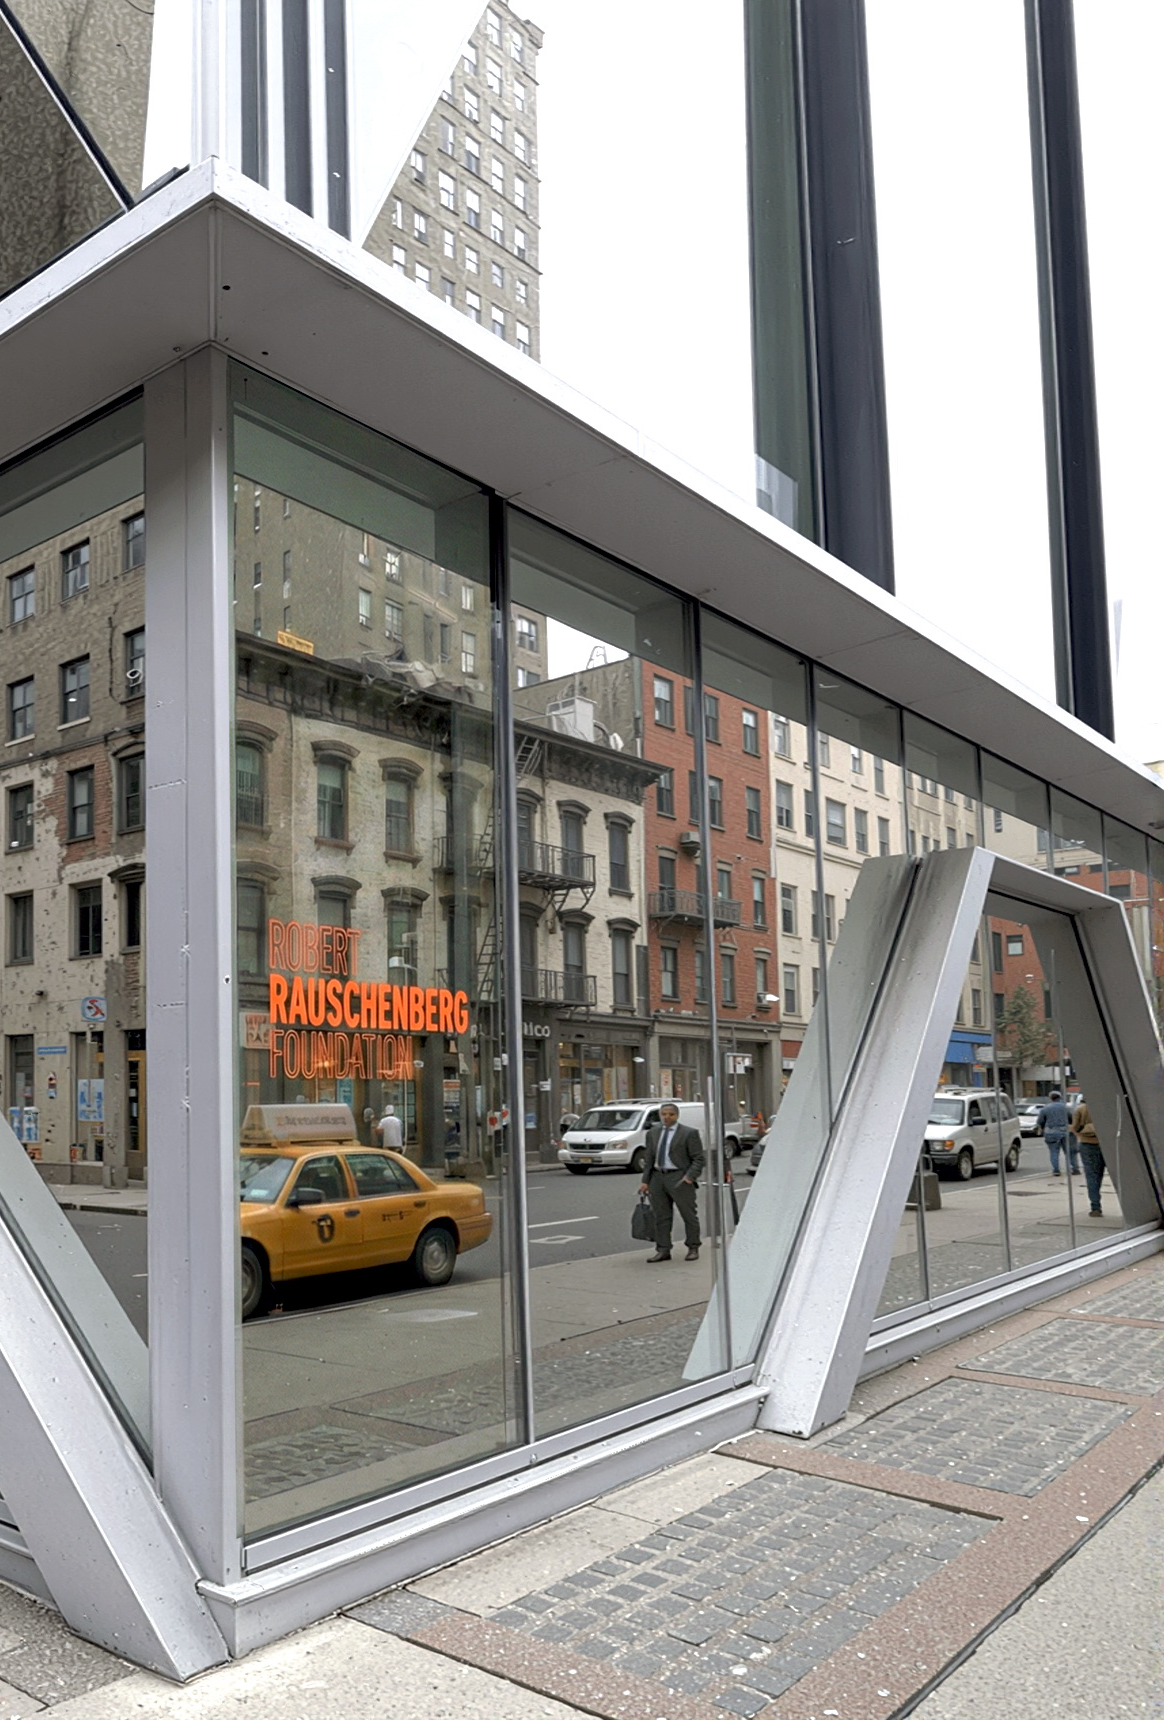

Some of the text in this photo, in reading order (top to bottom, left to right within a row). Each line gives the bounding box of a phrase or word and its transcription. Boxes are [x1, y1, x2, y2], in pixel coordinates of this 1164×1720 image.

[269, 918, 362, 976] ROBERT
[269, 973, 469, 1034] RAUSCHENBERG
[269, 1029, 413, 1080] FOUNDATION
